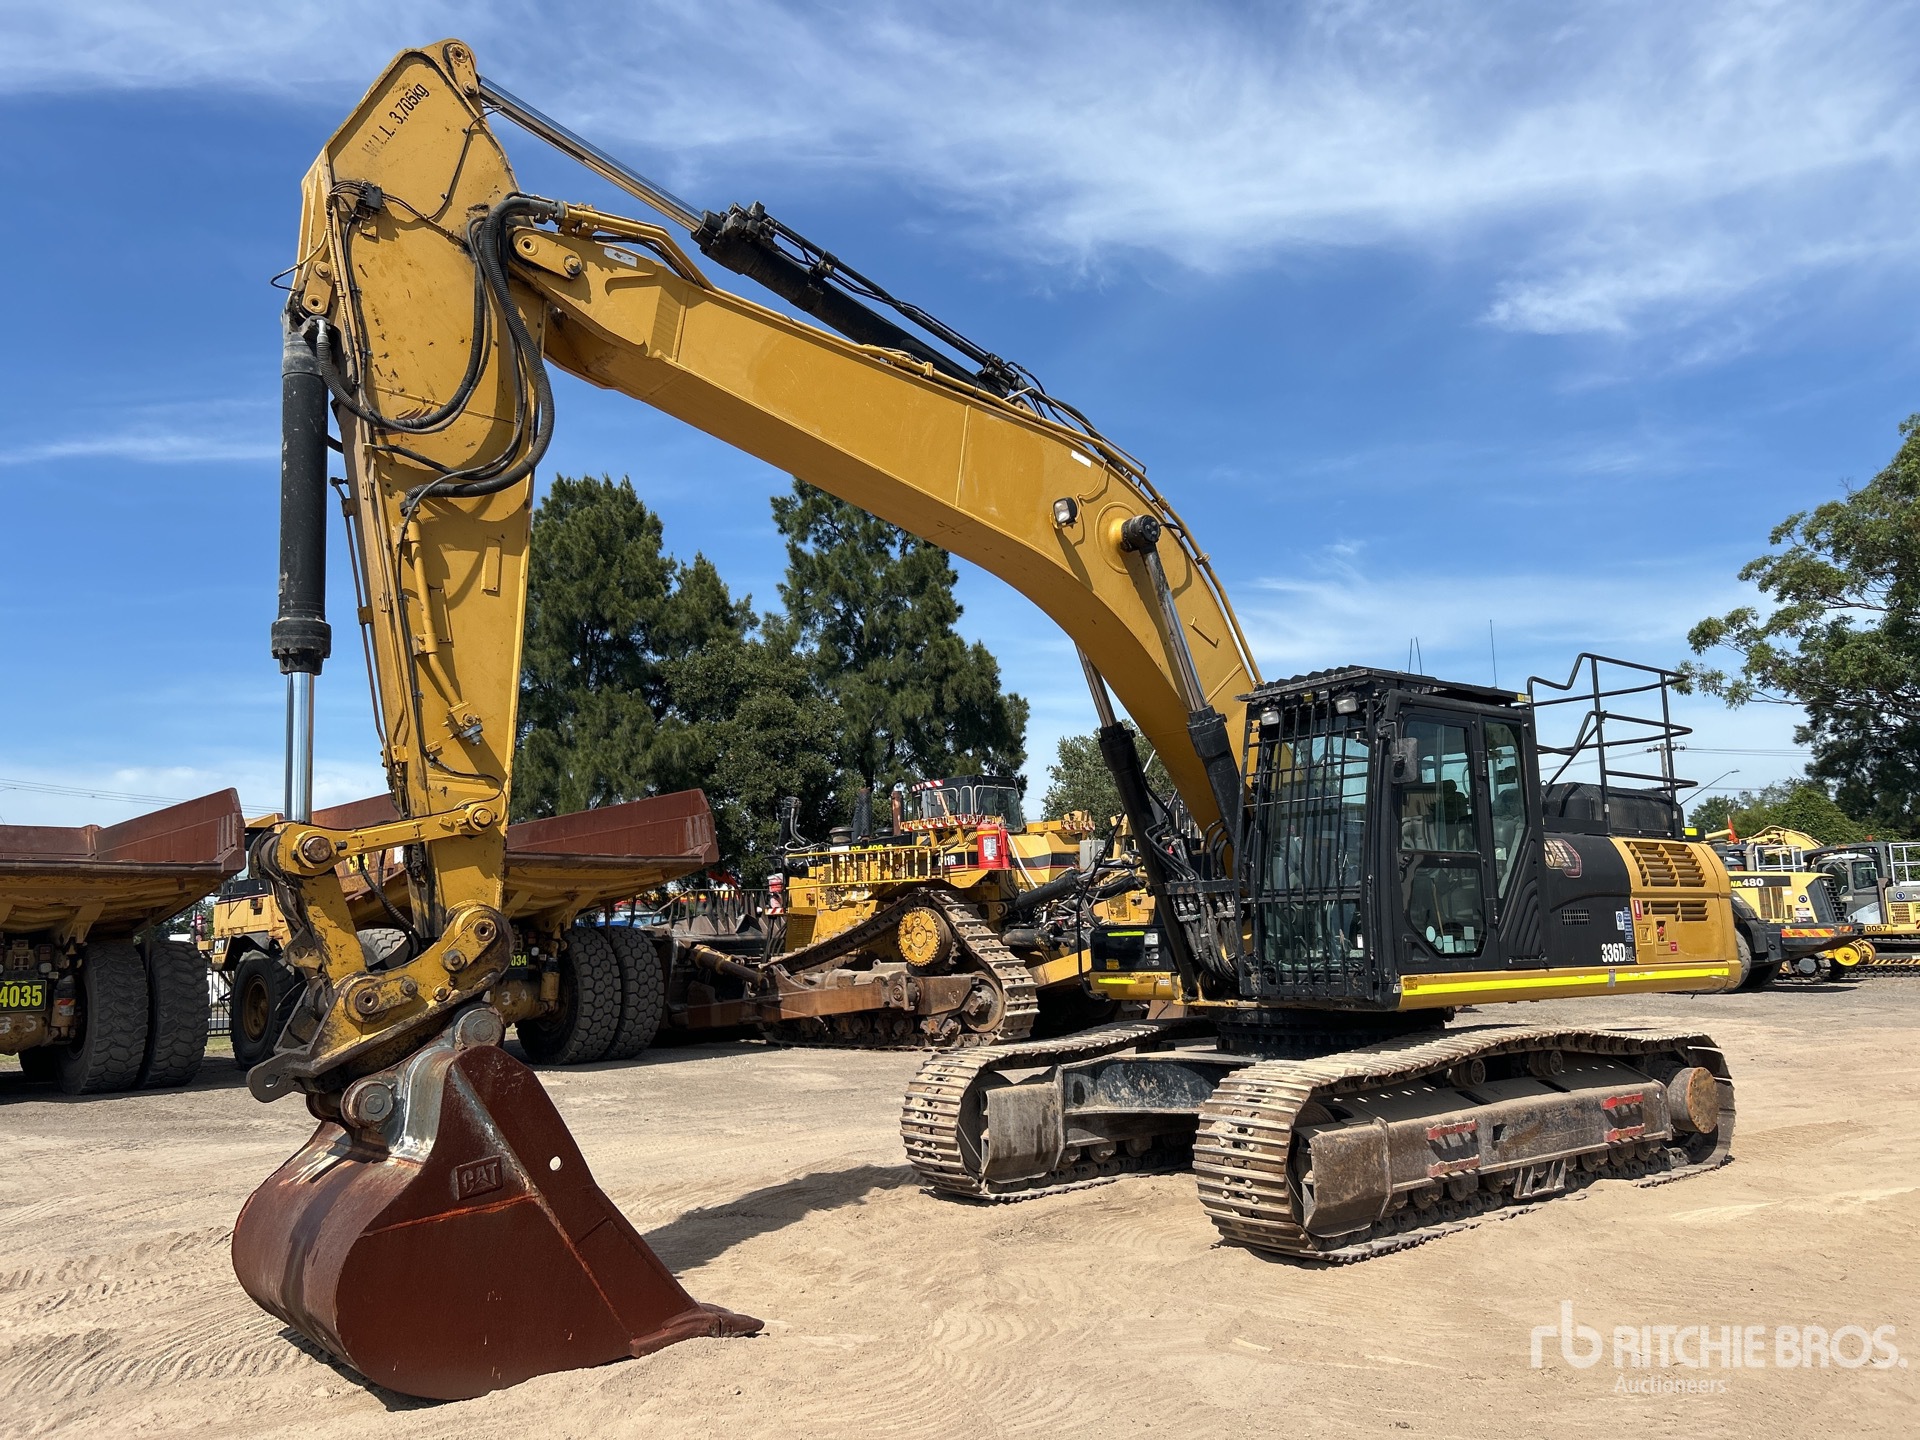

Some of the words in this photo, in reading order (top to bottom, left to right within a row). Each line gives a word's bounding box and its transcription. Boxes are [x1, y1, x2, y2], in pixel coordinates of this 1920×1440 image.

[388, 83, 430, 125] 3,705kg
[0, 984, 43, 1008] 4035
[461, 1162, 498, 1194] CAT
